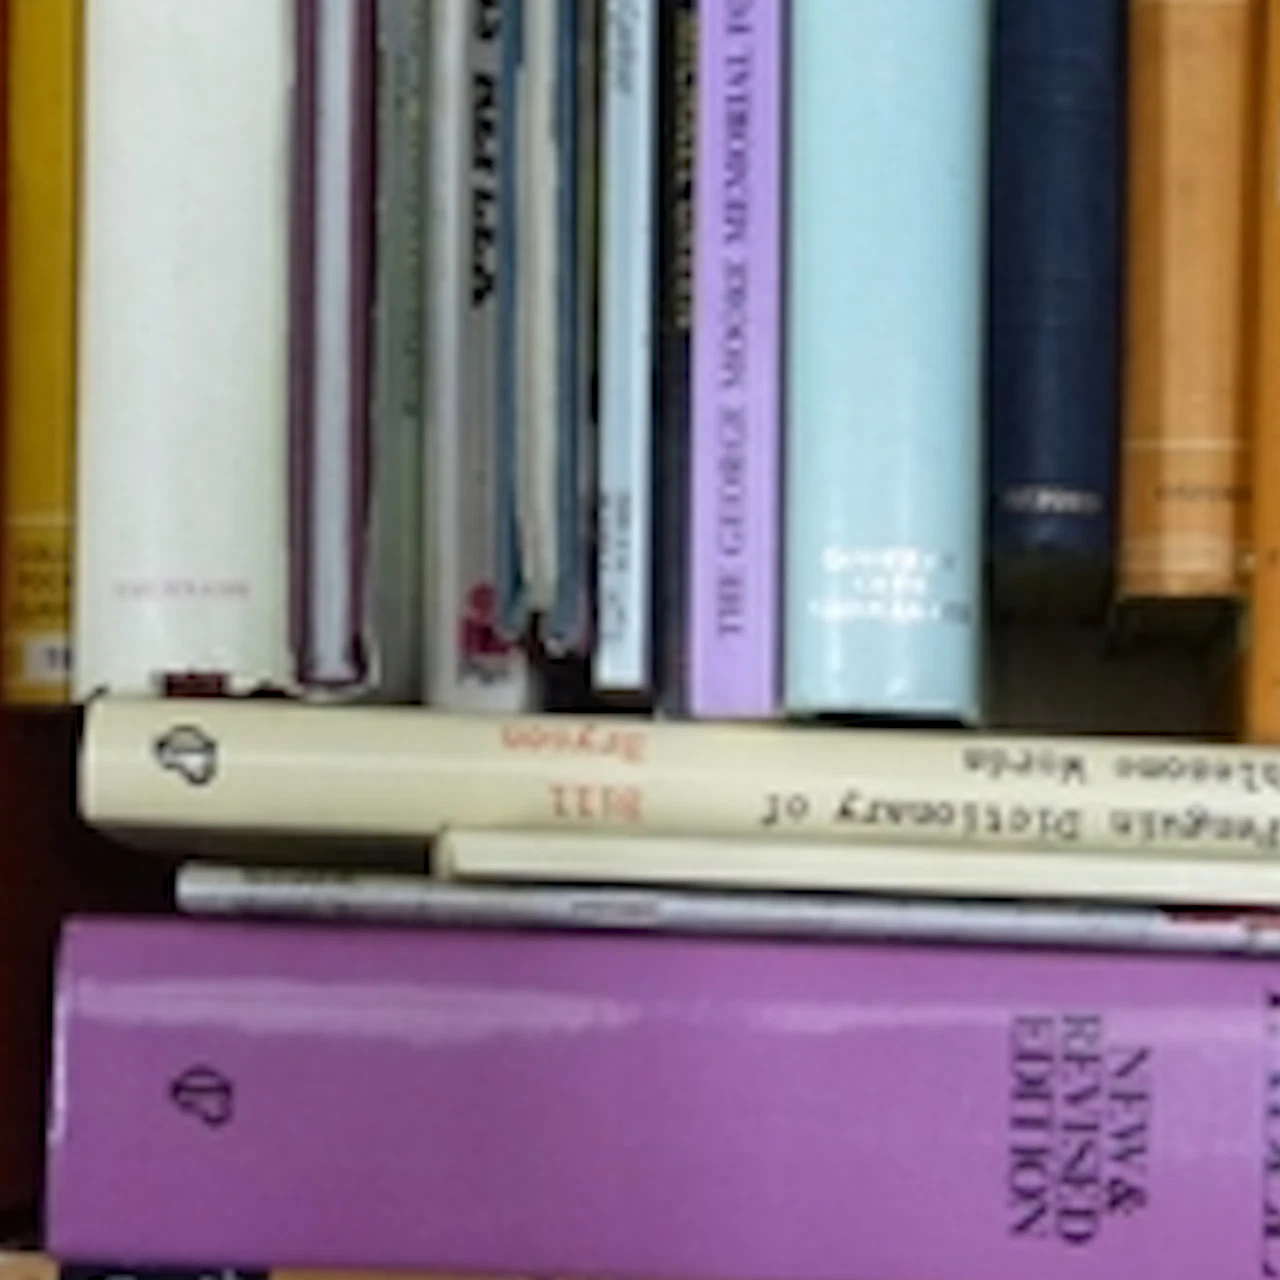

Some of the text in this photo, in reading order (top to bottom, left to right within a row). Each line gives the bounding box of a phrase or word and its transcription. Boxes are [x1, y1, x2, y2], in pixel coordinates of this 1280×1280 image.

[721, 50, 753, 246] MEMORIAL
[716, 399, 747, 559] GEORGE
[716, 566, 746, 641] THE
[499, 724, 646, 765] Bryson
[962, 747, 1088, 787] Words
[548, 783, 644, 824] Bill
[758, 791, 810, 828] of
[834, 789, 1081, 843] Dictionary
[1006, 1015, 1053, 1240] EDITION
[1056, 1013, 1102, 1247] REVISED
[1105, 1047, 1150, 1217] NEW &
